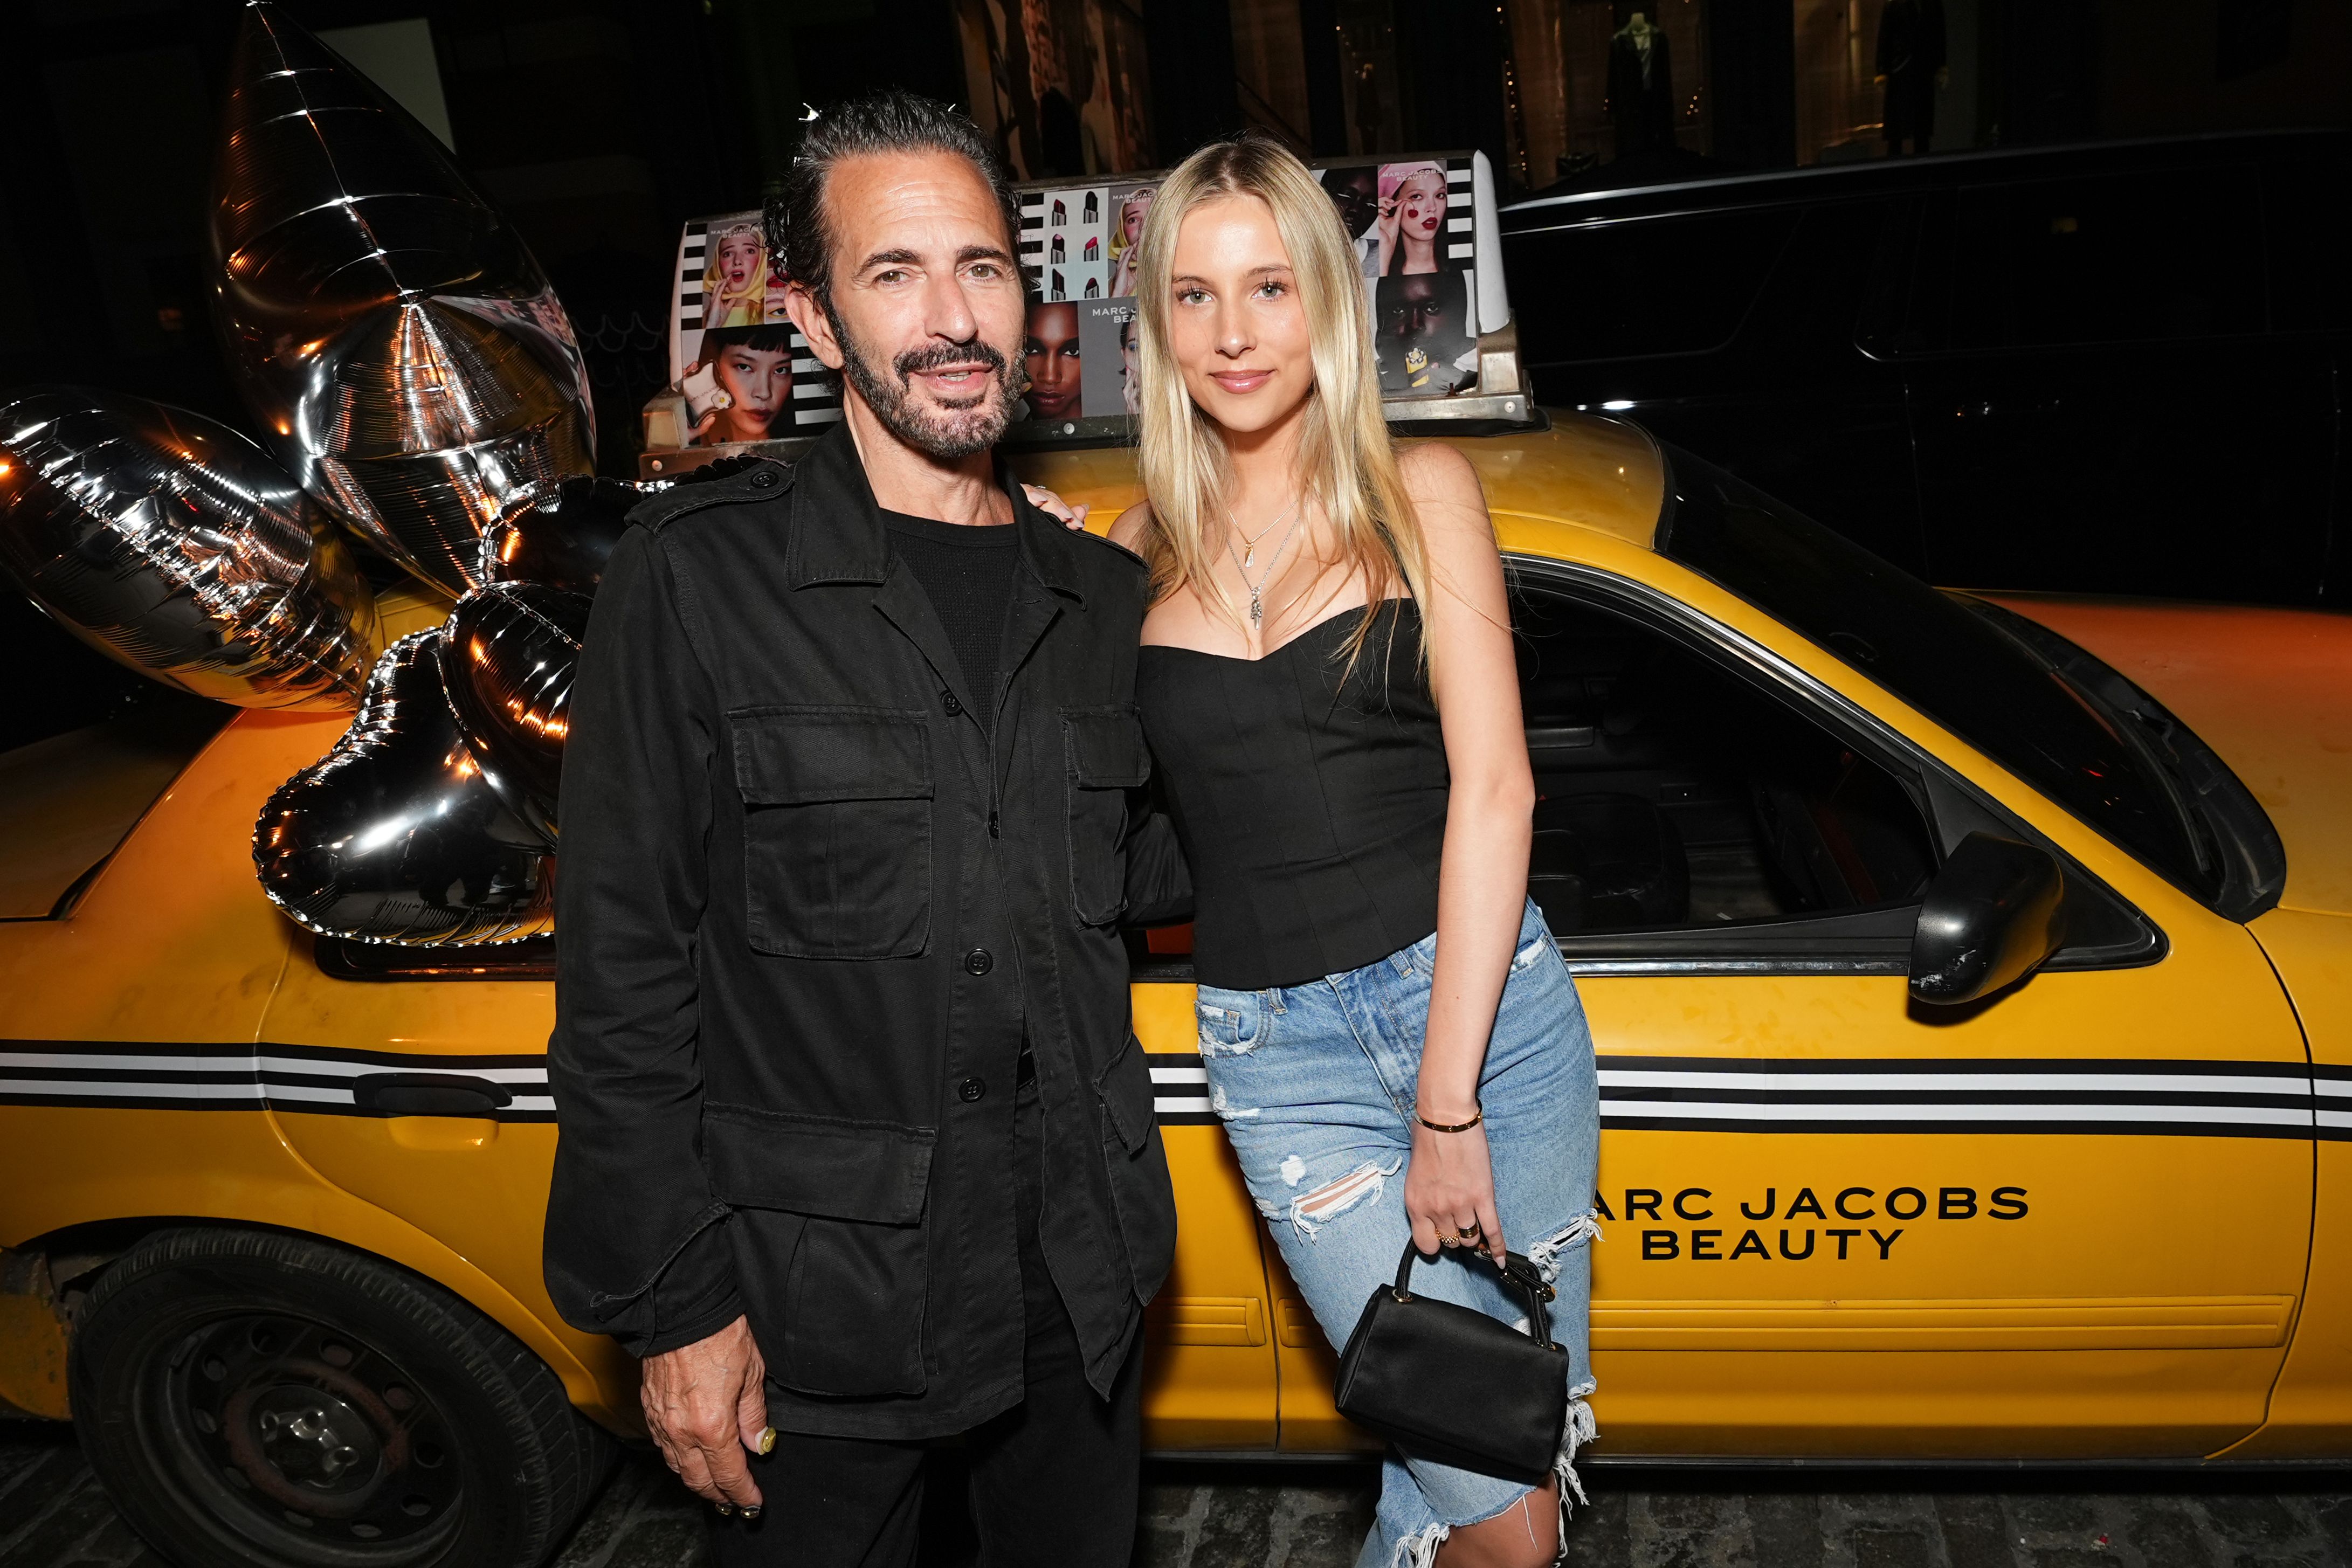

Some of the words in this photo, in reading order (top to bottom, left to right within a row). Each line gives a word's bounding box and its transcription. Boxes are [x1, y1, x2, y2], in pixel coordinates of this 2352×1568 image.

[1092, 306, 1127, 316] MARC
[1113, 314, 1136, 323] BEA
[1594, 1187, 1714, 1221] ARC
[1740, 1186, 2029, 1220] JACOBS
[1641, 1229, 1905, 1260] BEAUTY
